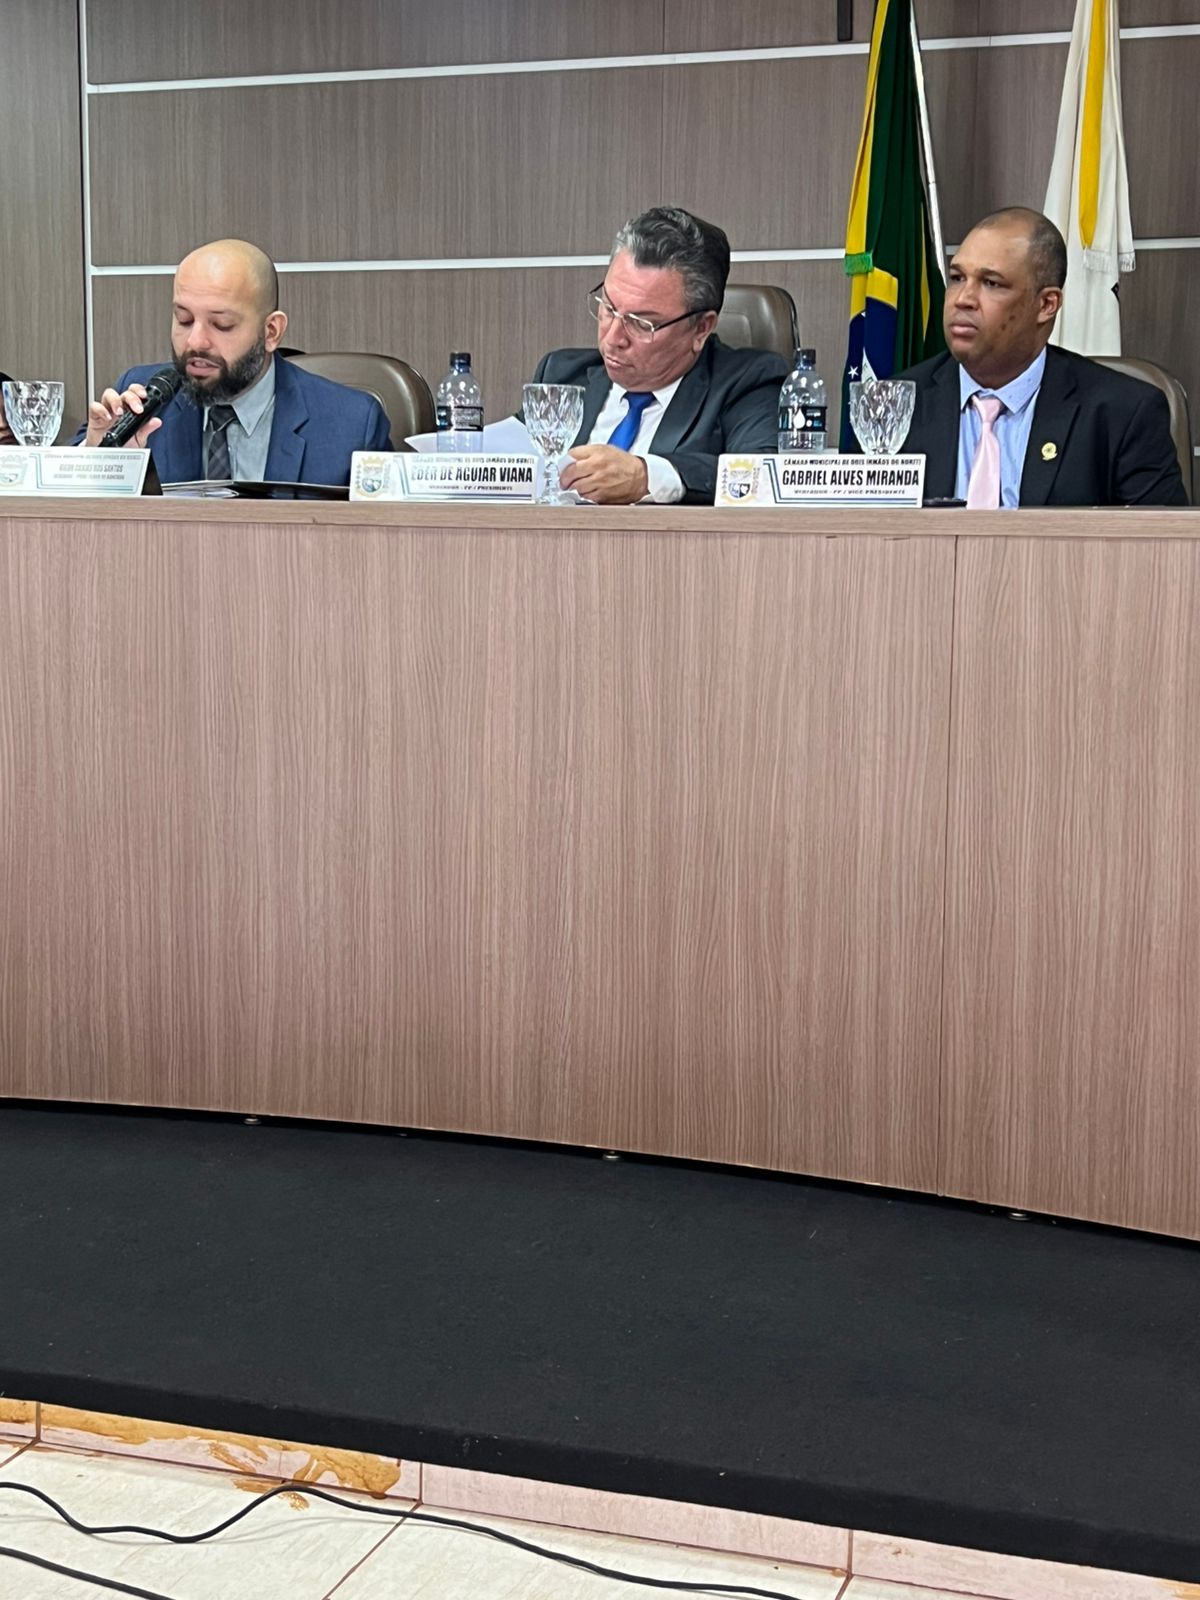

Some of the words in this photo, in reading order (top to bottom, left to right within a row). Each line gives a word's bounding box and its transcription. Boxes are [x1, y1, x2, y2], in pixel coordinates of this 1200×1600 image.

[440, 465, 453, 481] DE
[455, 466, 497, 482] AGUIAR
[499, 466, 533, 483] VIANA
[782, 469, 828, 486] GABRIEL
[830, 469, 864, 486] ALVES
[866, 469, 919, 486] MIRANDA
